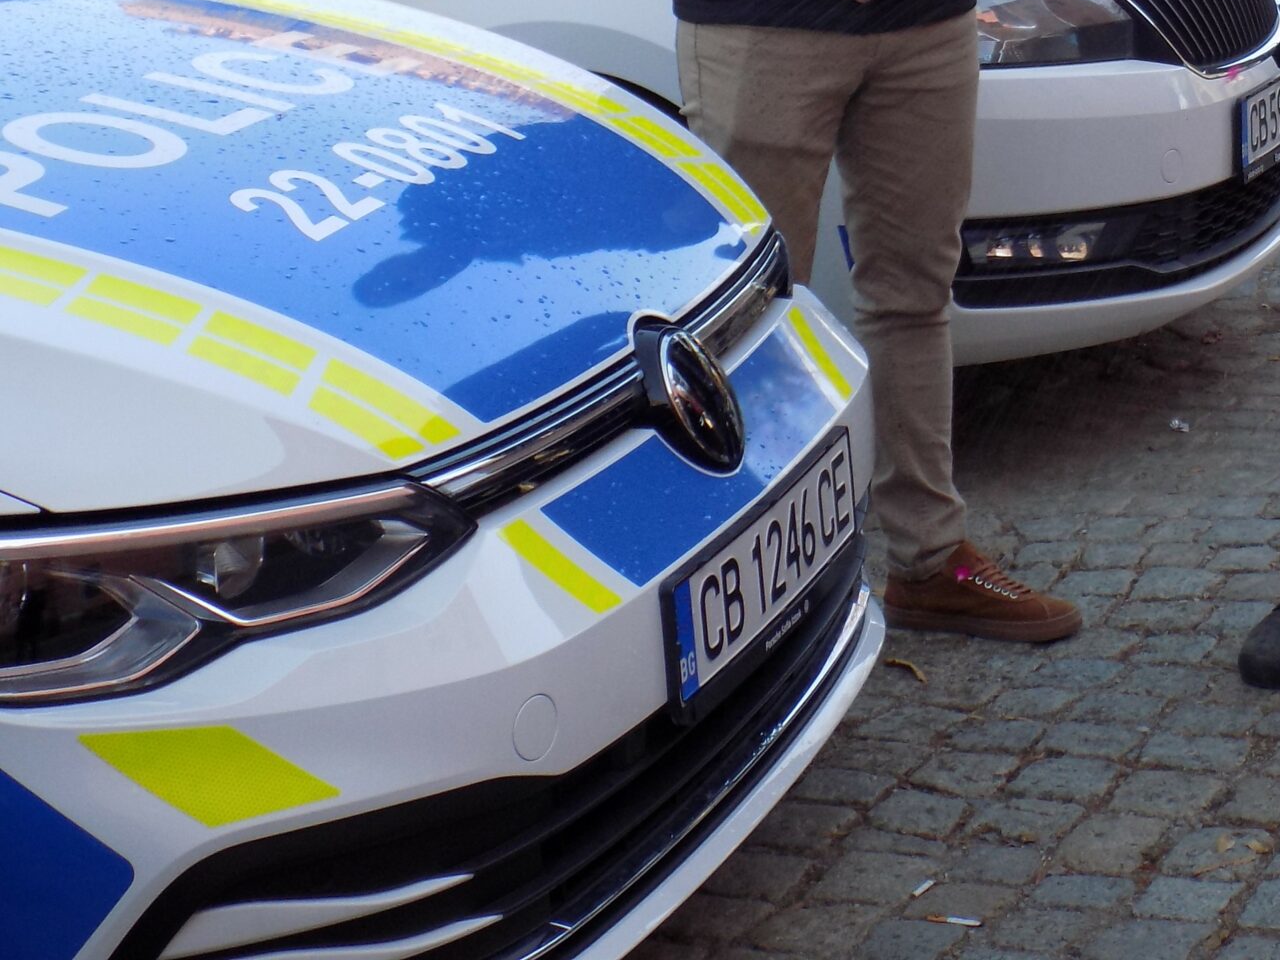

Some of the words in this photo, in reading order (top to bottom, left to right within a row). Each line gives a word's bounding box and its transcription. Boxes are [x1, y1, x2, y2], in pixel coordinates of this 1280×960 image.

[230, 102, 526, 241] 22-0801
[700, 557, 745, 660] CB
[752, 488, 816, 614] 1246
[817, 451, 850, 546] CE
[680, 652, 696, 683] BG
